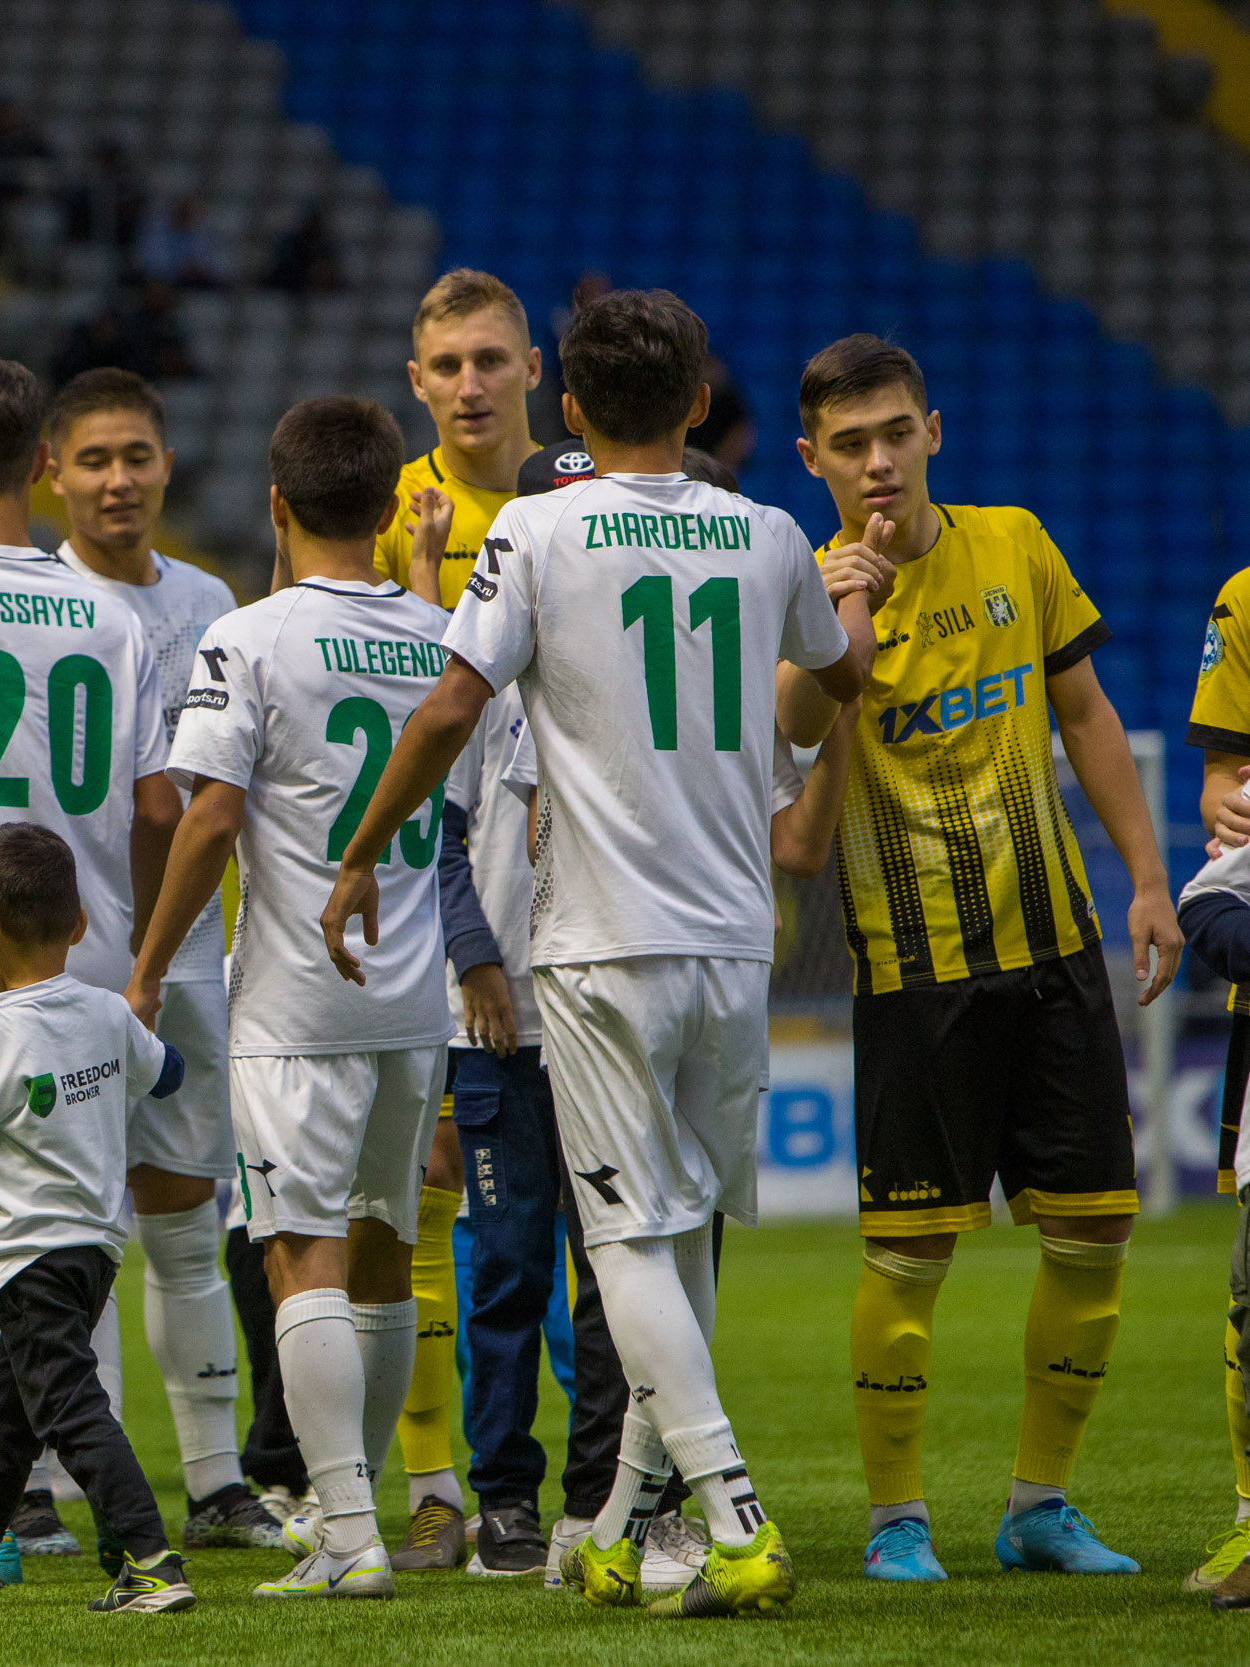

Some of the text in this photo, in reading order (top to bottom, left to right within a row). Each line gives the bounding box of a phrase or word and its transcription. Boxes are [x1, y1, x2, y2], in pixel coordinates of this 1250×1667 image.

[581, 512, 751, 551] ZHARDEMOV
[932, 603, 976, 639] SILA
[620, 575, 742, 752] 11
[877, 663, 1033, 745] 1XBET
[60, 1058, 120, 1092] FREEDOM
[65, 1085, 101, 1106] BROKER
